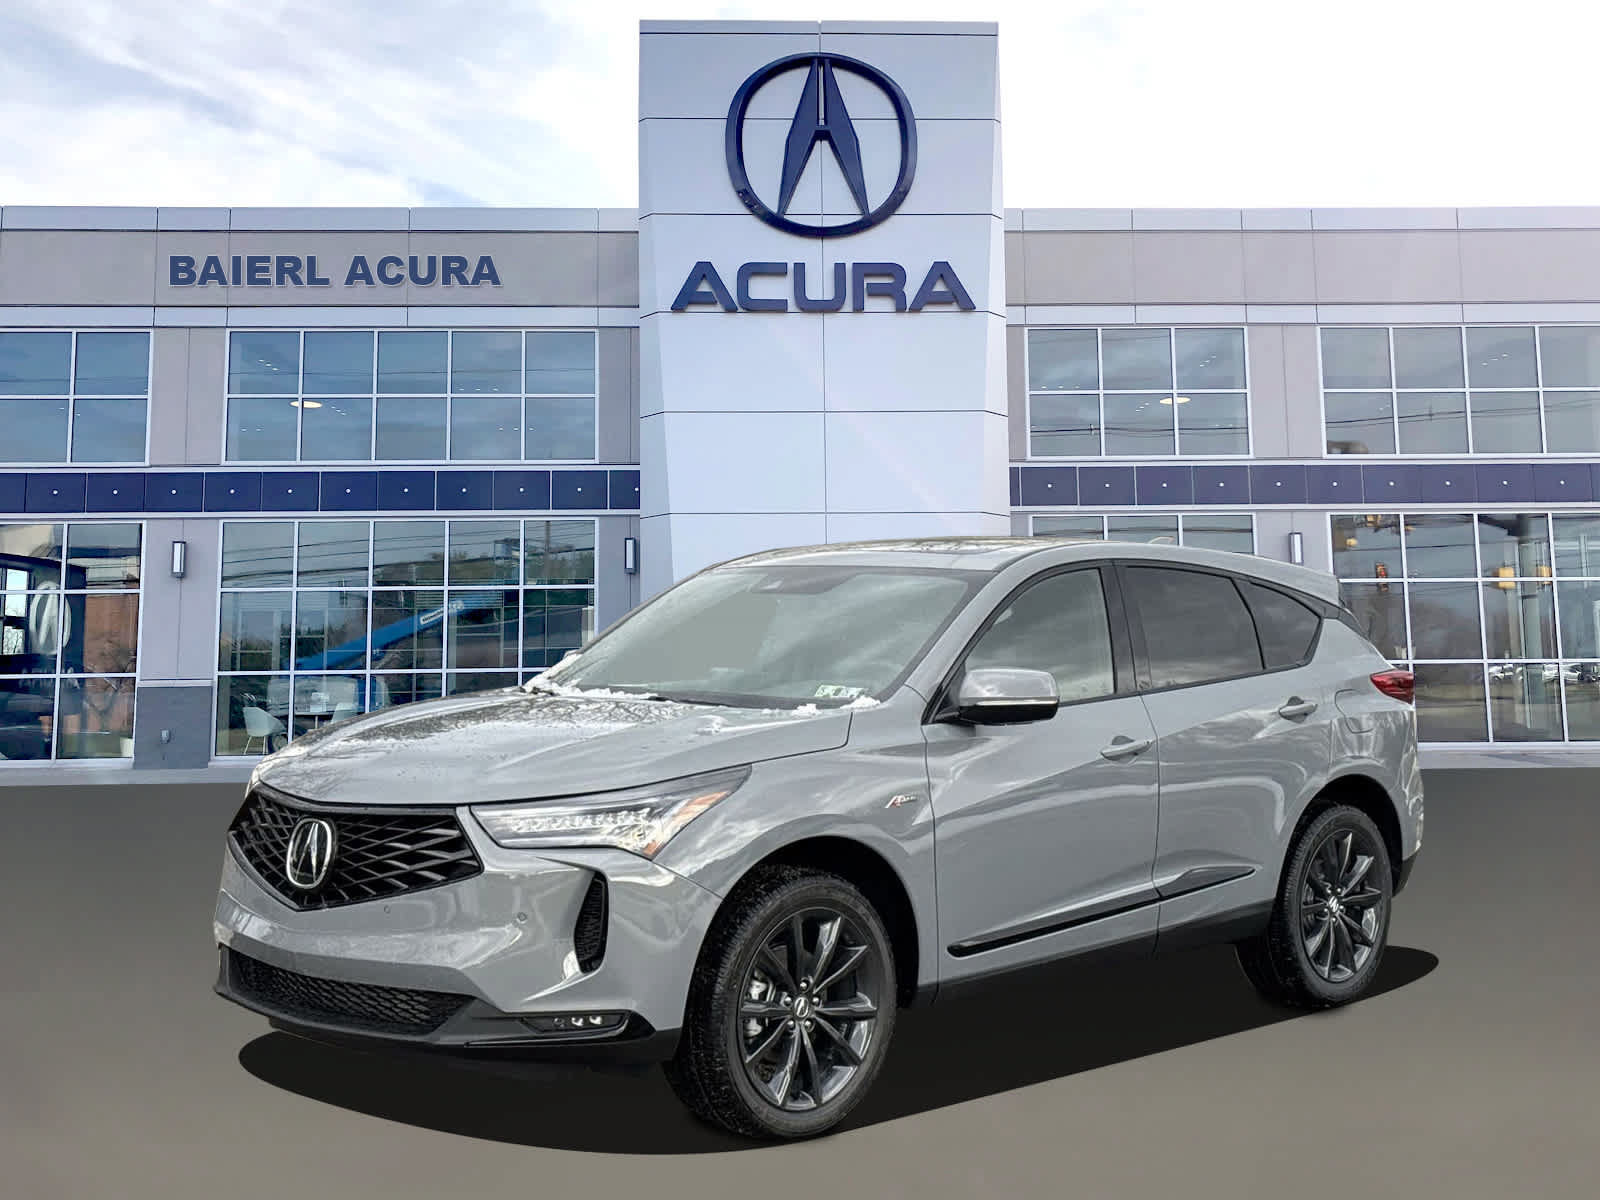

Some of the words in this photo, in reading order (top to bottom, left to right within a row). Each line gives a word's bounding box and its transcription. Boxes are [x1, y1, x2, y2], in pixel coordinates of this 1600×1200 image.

[169, 255, 330, 286] BAIERL
[344, 255, 501, 286] ACURA
[670, 261, 977, 313] ACURA
